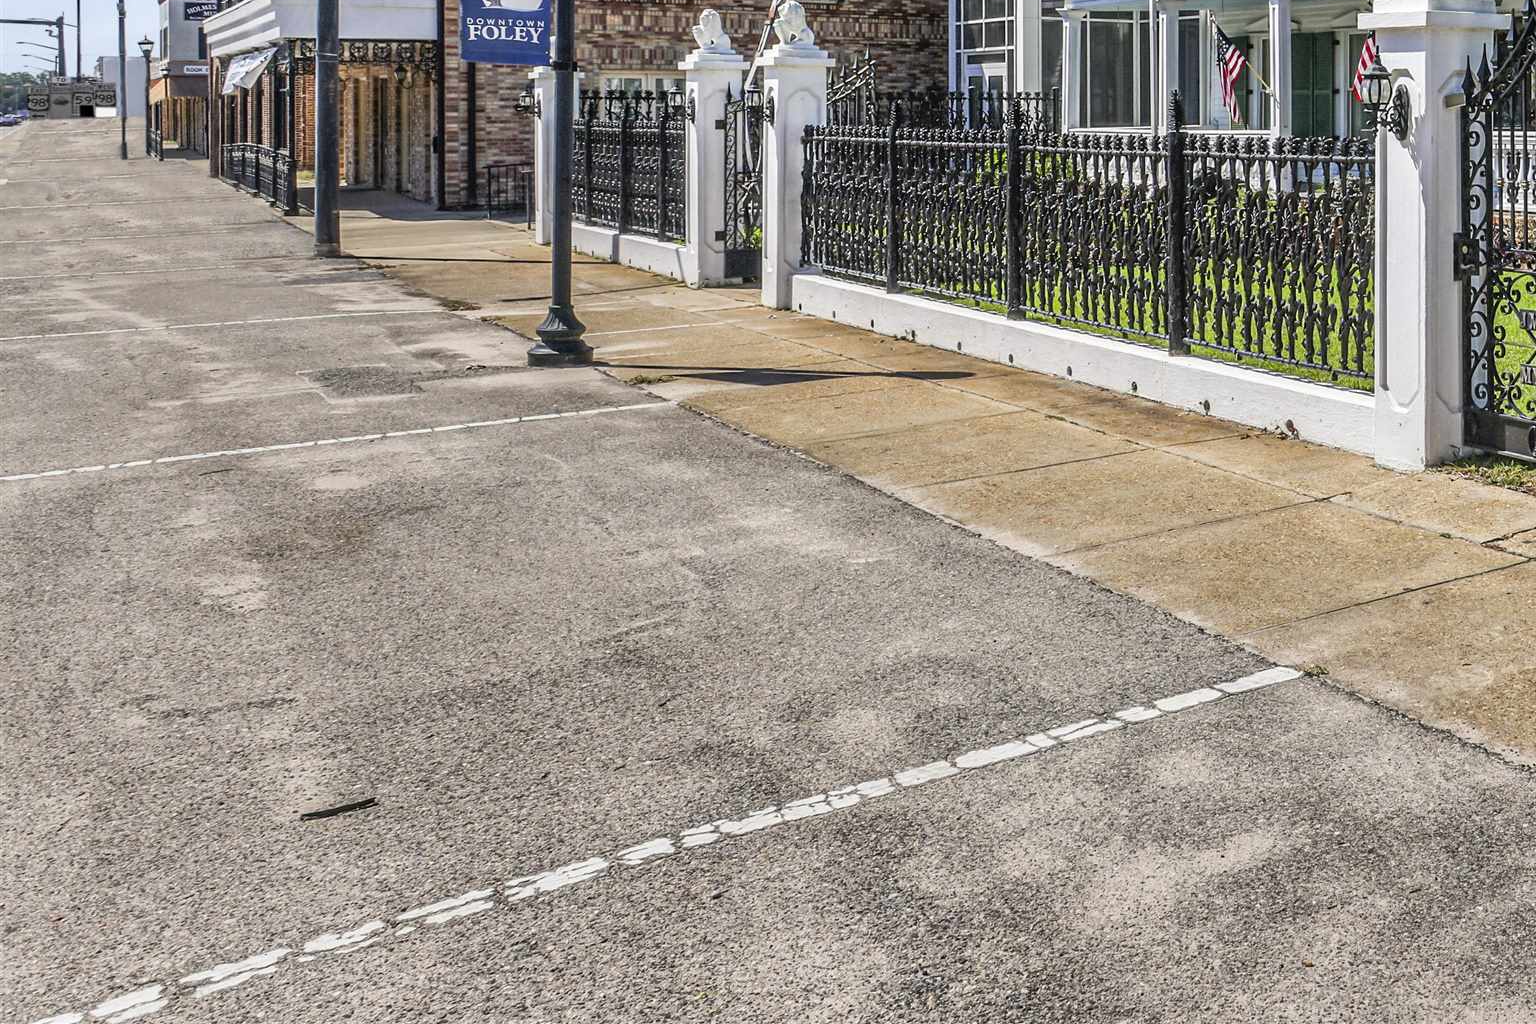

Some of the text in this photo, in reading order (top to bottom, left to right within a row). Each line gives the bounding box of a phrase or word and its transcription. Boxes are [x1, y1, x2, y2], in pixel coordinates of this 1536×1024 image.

[186, 4, 217, 15] HOLMES
[466, 17, 545, 27] DOWNTOWN
[467, 25, 544, 44] FOLEY
[31, 98, 46, 107] 98
[75, 95, 92, 105] 59
[98, 94, 113, 103] 98
